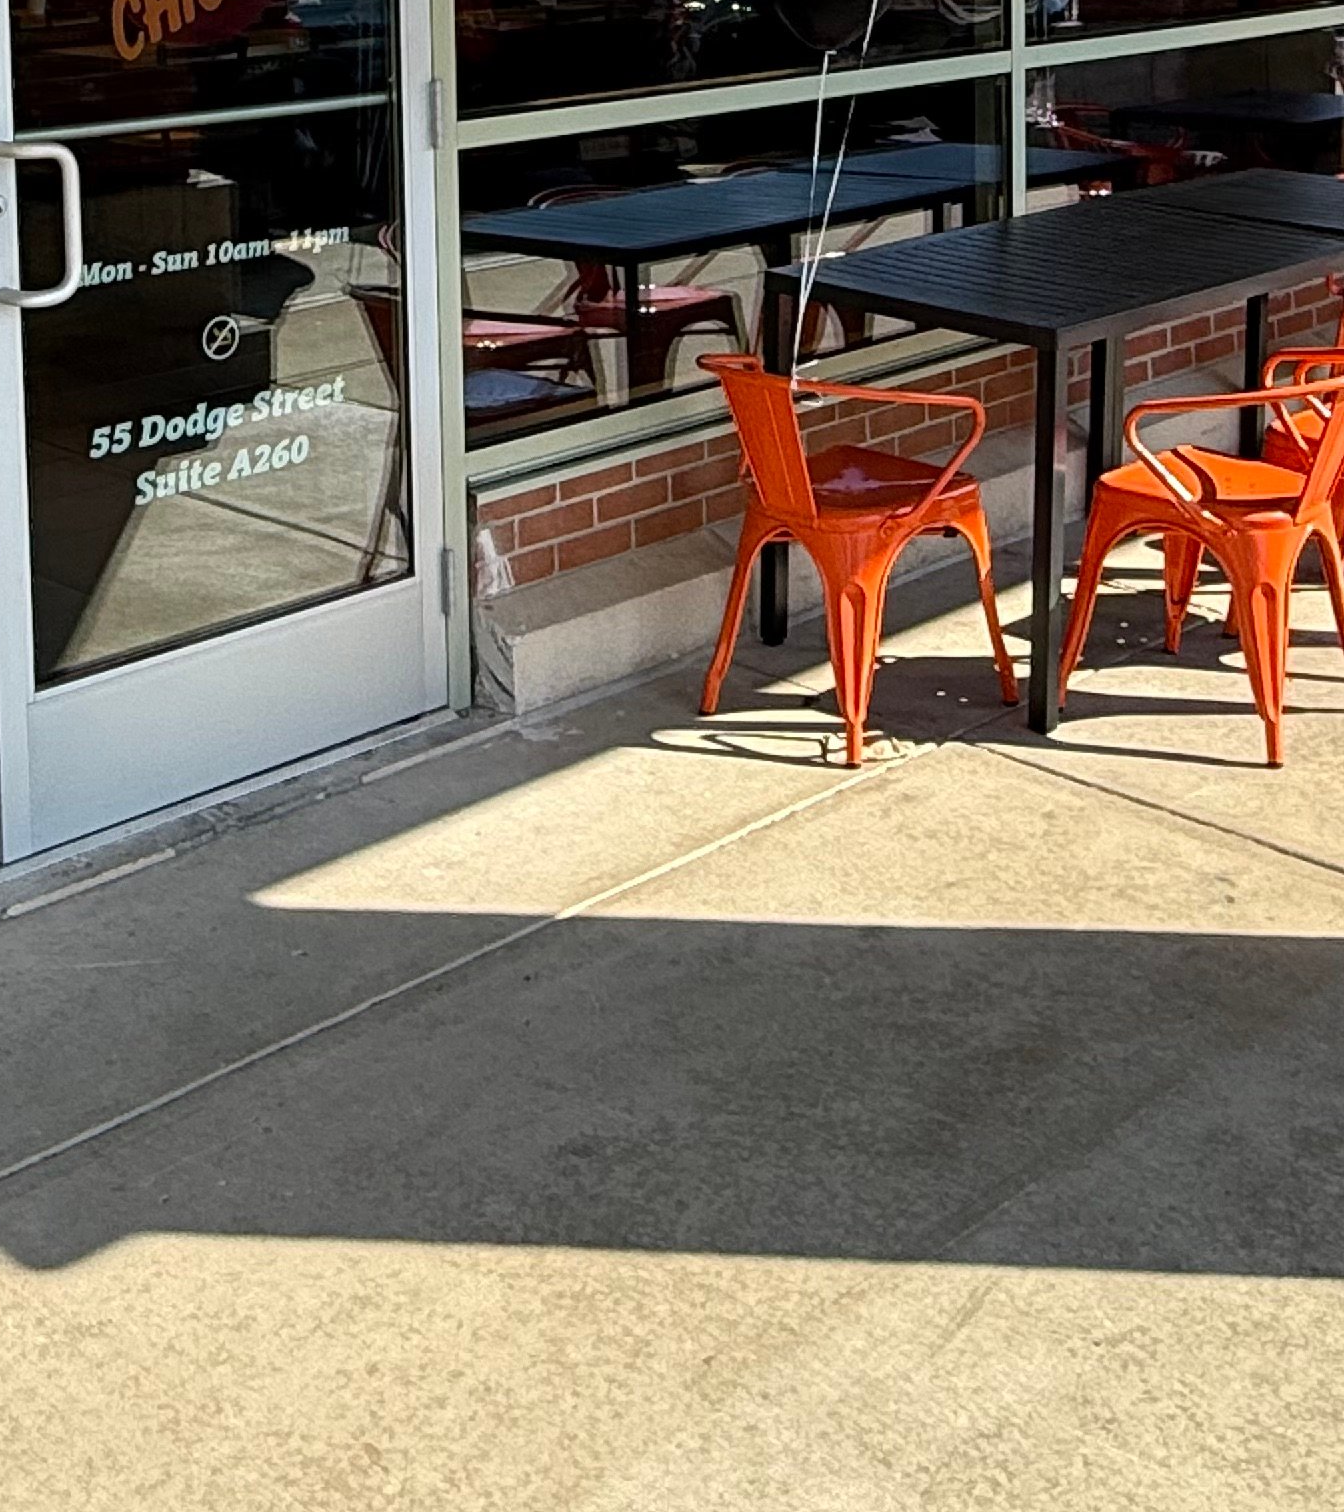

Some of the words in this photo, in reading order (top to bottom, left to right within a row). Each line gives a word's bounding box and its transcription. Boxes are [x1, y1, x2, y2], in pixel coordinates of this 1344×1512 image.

[76, 260, 133, 288] Mon
[150, 250, 199, 276] Sun
[205, 238, 270, 266] 10am
[288, 226, 350, 255] 11pm
[89, 420, 133, 459] 55
[138, 402, 244, 448] Dodge
[251, 374, 346, 423] Street
[135, 458, 222, 506] Suite
[227, 434, 310, 480] A260
